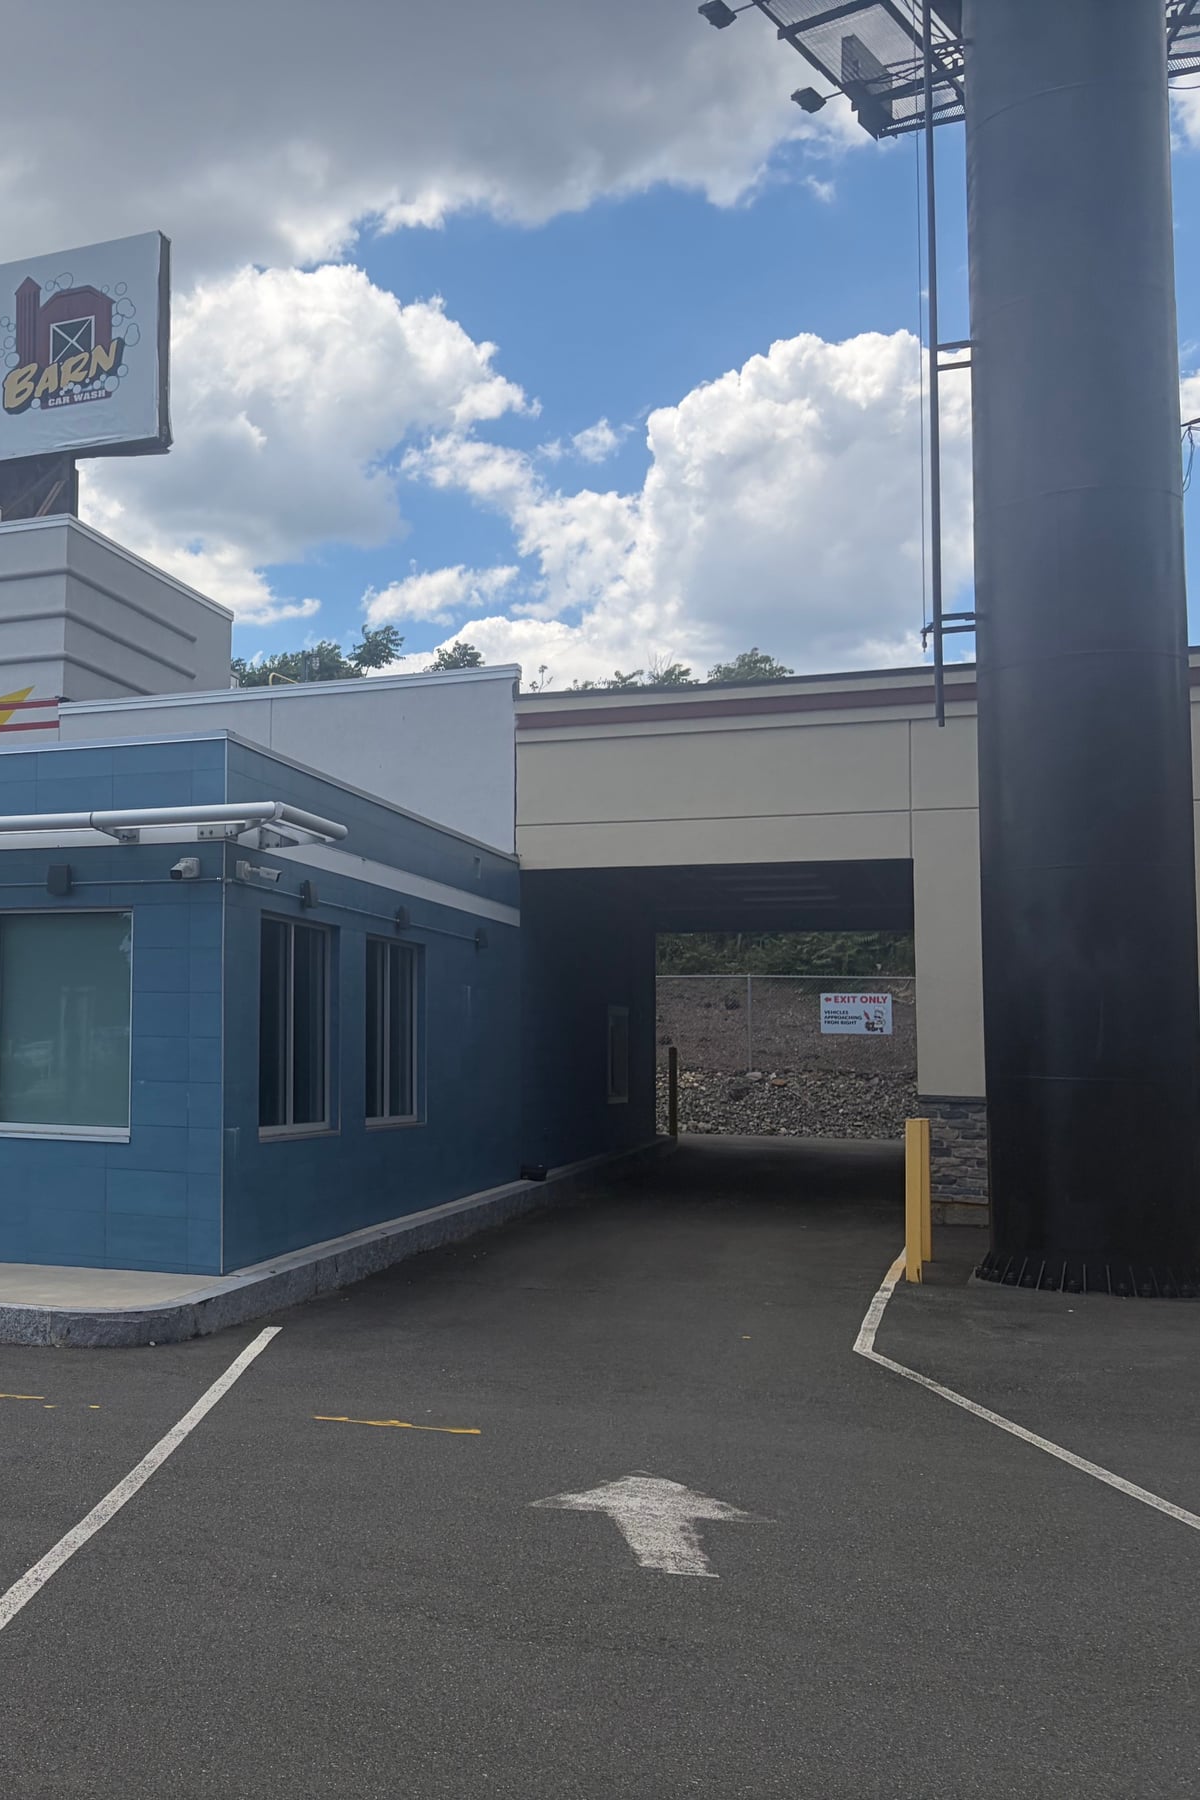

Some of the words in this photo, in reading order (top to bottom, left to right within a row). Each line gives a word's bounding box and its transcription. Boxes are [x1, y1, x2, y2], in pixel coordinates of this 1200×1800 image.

[3, 339, 119, 411] BARN
[48, 396, 70, 407] CAR
[73, 389, 106, 402] WASH
[833, 995, 857, 1004] EXIT
[860, 995, 888, 1004] ONLY
